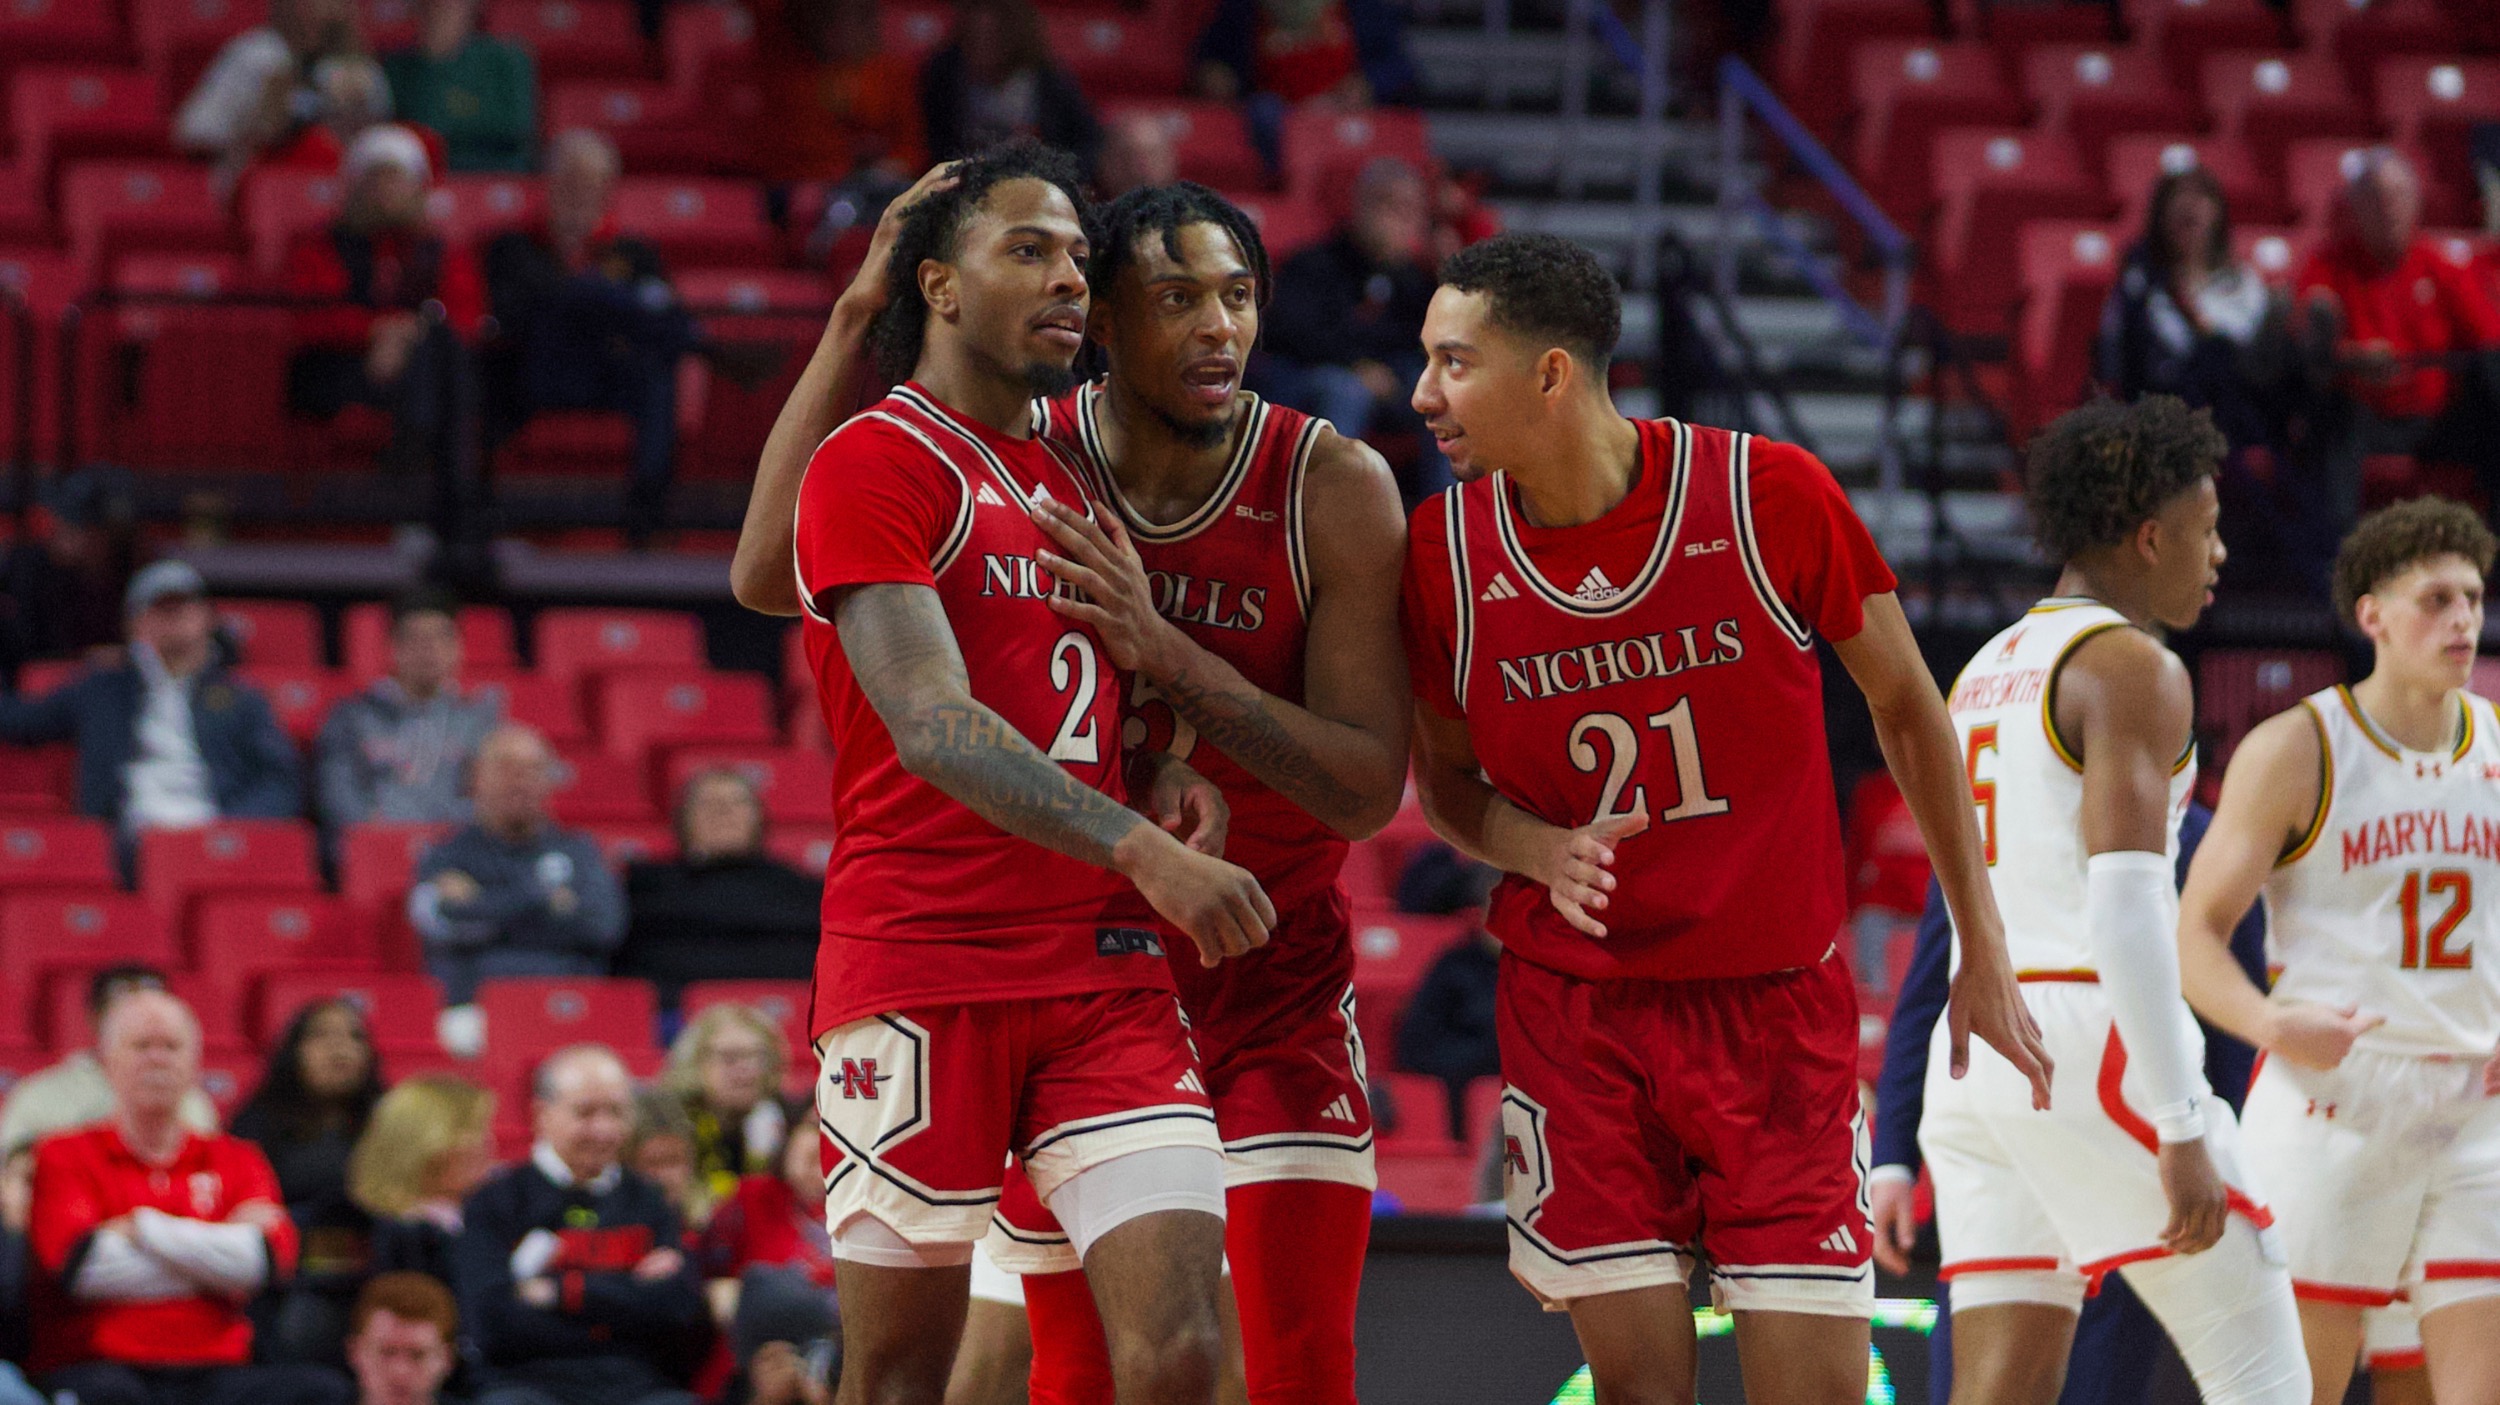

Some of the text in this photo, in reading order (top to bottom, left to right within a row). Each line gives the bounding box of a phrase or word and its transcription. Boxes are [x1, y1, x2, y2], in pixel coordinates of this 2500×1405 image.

[1047, 630, 1099, 765] 2
[1496, 618, 1746, 703] NICHOLLS
[1567, 694, 1731, 825] 21
[2397, 867, 2473, 970] 12
[841, 1057, 879, 1100] N
